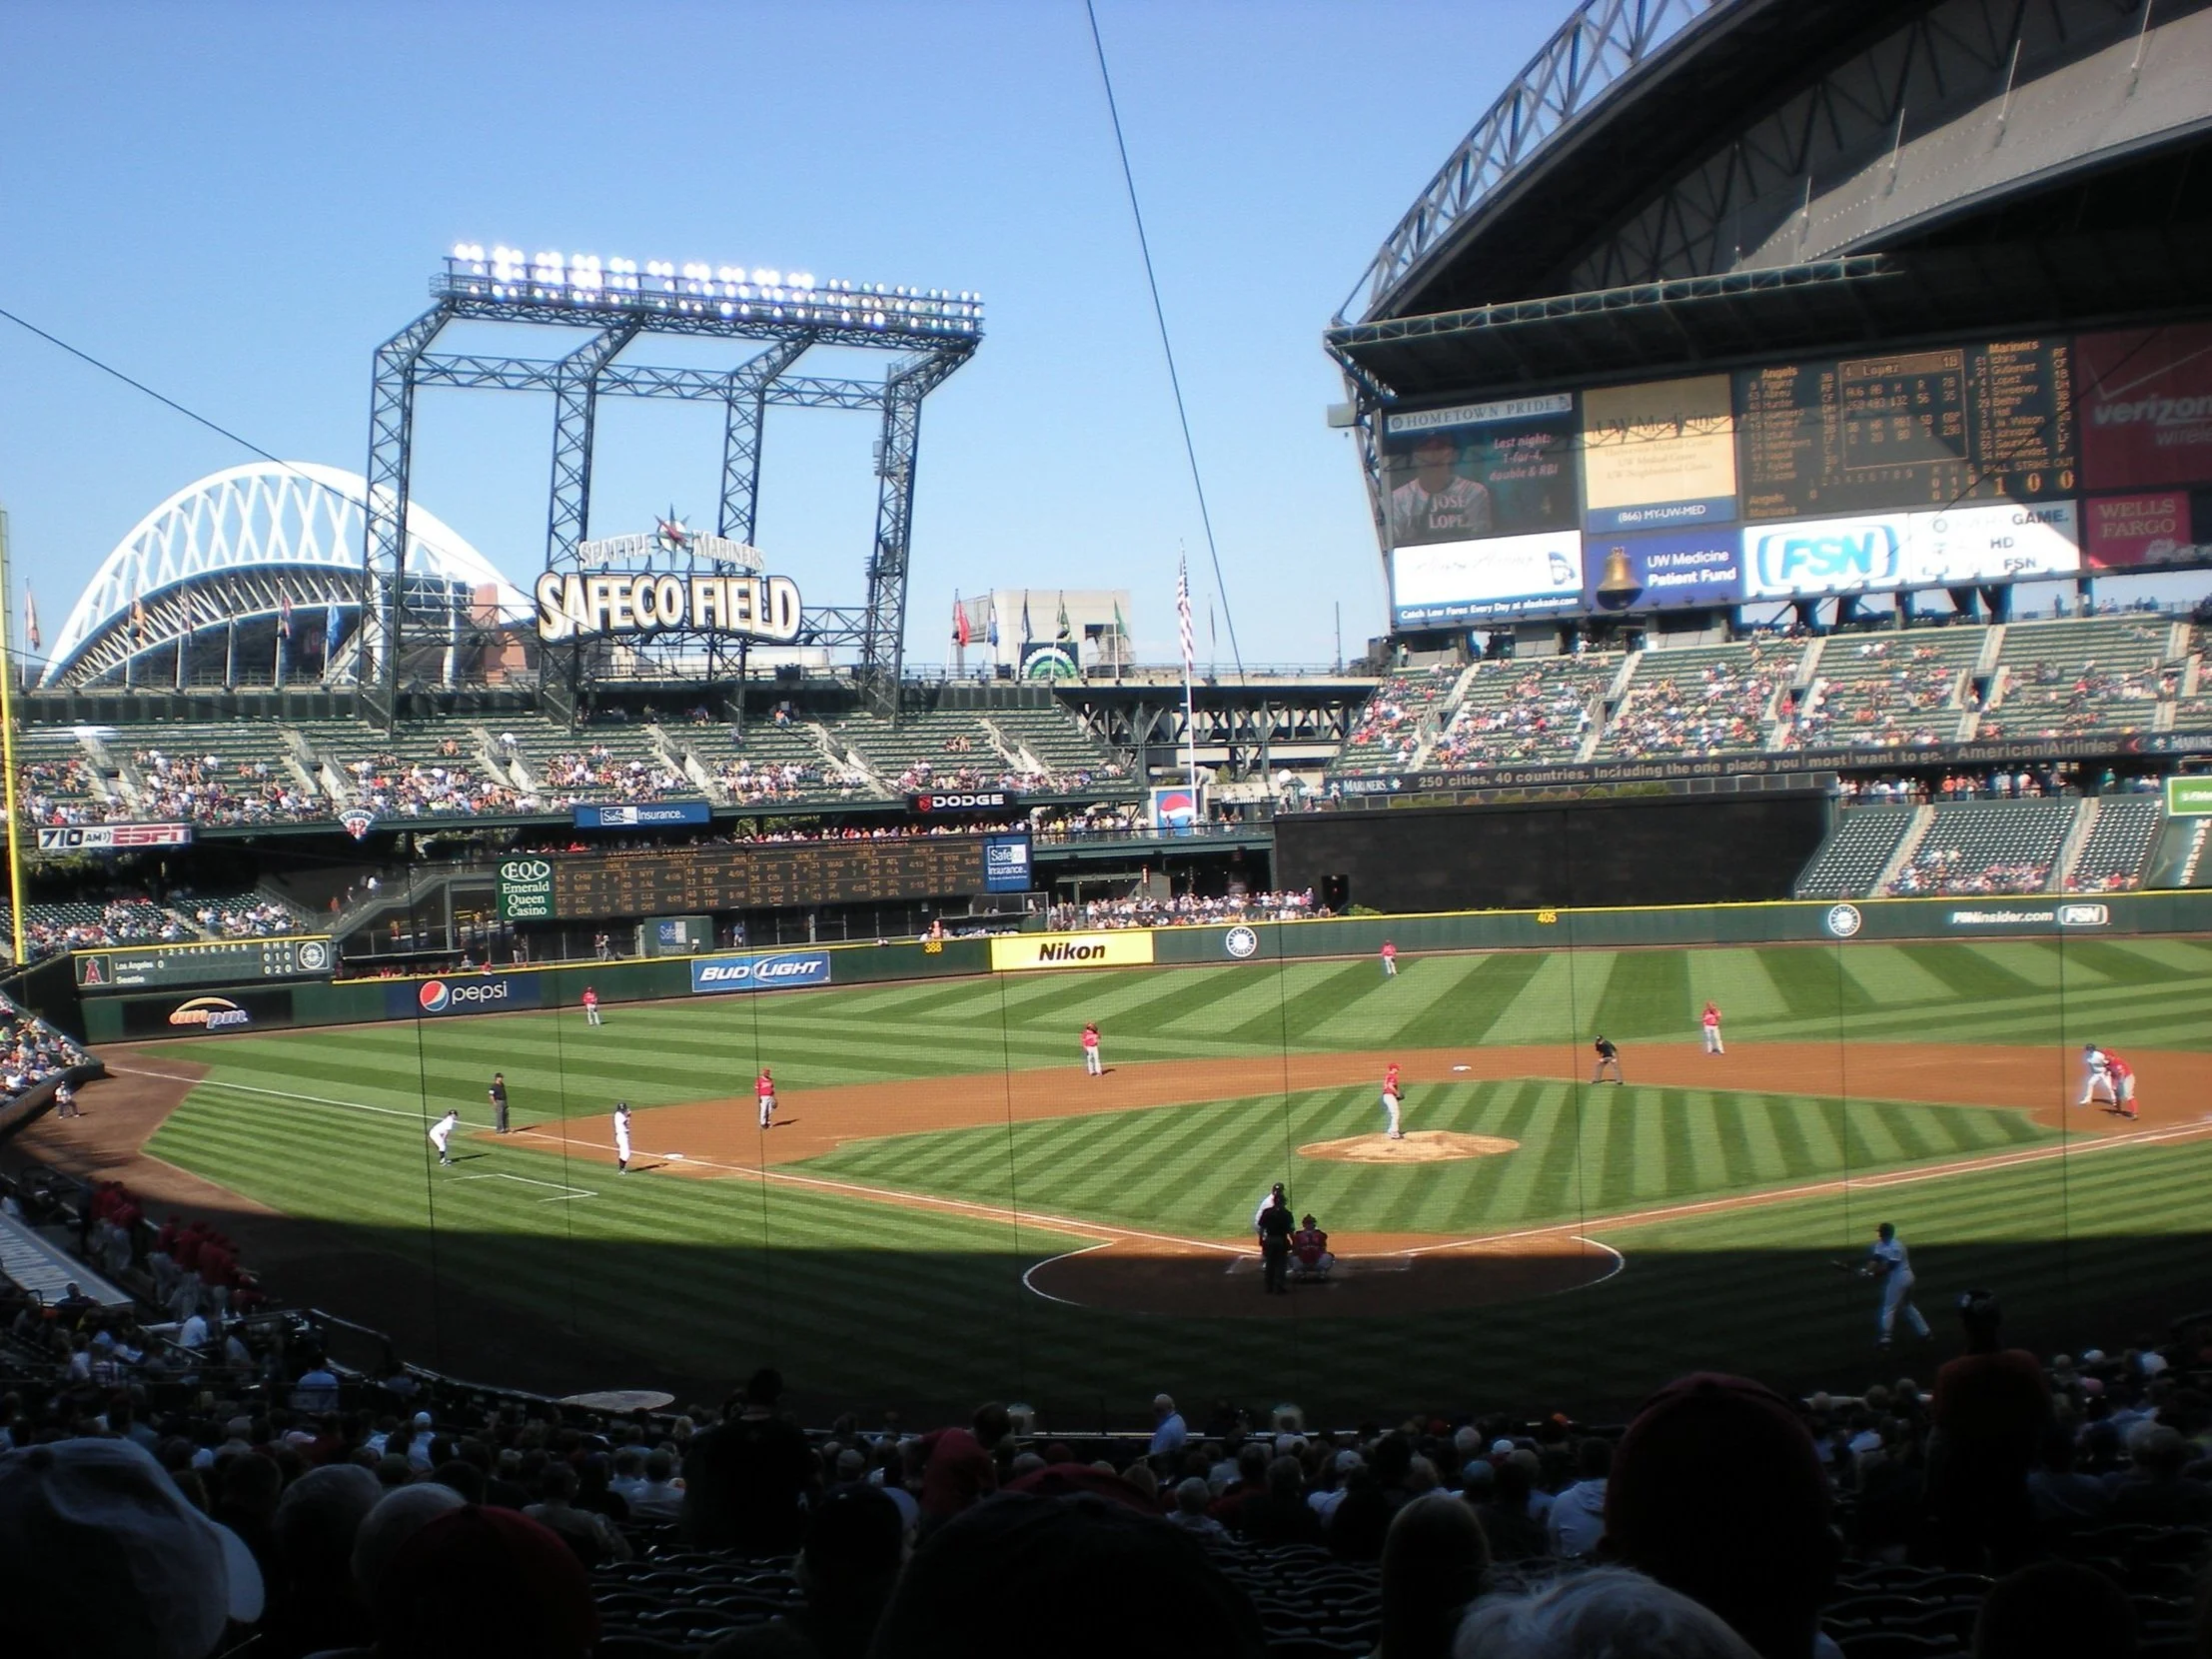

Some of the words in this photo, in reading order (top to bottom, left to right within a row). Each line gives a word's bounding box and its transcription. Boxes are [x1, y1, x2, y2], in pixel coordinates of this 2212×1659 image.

[1989, 341, 2038, 353] Mariners
[1762, 367, 1798, 379] Angels
[1863, 364, 1899, 377] Lopez
[1943, 356, 1958, 368] 1B
[1407, 406, 1498, 428] HOMETOWN
[1507, 399, 1555, 415] PRIDE
[1637, 409, 1720, 433] Medicine
[1494, 438, 1516, 450] Last
[2014, 459, 2050, 471] STRIKE
[2054, 457, 2074, 468] OUT
[2027, 473, 2042, 492] 0
[2059, 470, 2075, 489] 0
[1618, 512, 1643, 524] (866)
[1645, 504, 1706, 520] MY-UW-MED
[2011, 509, 2070, 527] GAME.
[2098, 499, 2175, 519] WELLS
[2102, 519, 2176, 538] FARGO
[578, 533, 653, 570] SEATTLE
[691, 530, 766, 573] MARINERS
[1989, 537, 2014, 550] HD
[1648, 556, 1670, 568] UW
[1672, 550, 1729, 566] Medicine
[1780, 532, 1875, 579] FSN
[2003, 557, 2037, 571] FSN
[1649, 571, 1698, 588] Patient
[1701, 567, 1737, 583] Fund
[536, 571, 686, 644] SAFECO
[689, 574, 801, 645] FIELD
[1401, 610, 1426, 620] Catch
[1428, 608, 1445, 618] Low
[1446, 606, 1469, 616] Fares
[1470, 604, 1494, 616] Every
[1495, 602, 1512, 614] Day
[1513, 602, 1522, 611] at
[1343, 779, 1387, 793] MARINERS
[1418, 777, 1444, 789] 250
[1449, 774, 1491, 787] cities.
[1495, 772, 1512, 784] 40
[1516, 769, 1591, 784] countries.
[1595, 765, 1663, 781] Including
[1666, 763, 1689, 775] the
[1693, 760, 1720, 774] one
[1773, 758, 1798, 772] you
[1809, 754, 1847, 768] most
[1856, 751, 1894, 765] want
[1901, 751, 1915, 763] to
[932, 794, 1004, 808] DODGE
[602, 809, 636, 826] Safe
[638, 810, 681, 822] Insurance
[42, 830, 83, 847] 710
[85, 833, 101, 842] AM
[112, 824, 192, 844] ESPN
[509, 861, 549, 879] EQC
[502, 881, 551, 893] Emerald
[508, 893, 546, 906] Queen
[507, 905, 548, 917] Casino
[1538, 911, 1558, 923] 405
[1952, 910, 2054, 925] FSNinsider.com
[2065, 905, 2100, 923] FSN
[115, 961, 128, 970] Los
[157, 959, 164, 969] 0
[263, 952, 270, 961] 0
[284, 951, 291, 961] 0
[1039, 941, 1106, 961] Nikon
[116, 974, 145, 984] Seattle
[264, 964, 271, 974] 0
[275, 964, 281, 974] 2
[285, 964, 292, 973] 0
[699, 962, 751, 982] BUD
[759, 958, 824, 978] LIGHT
[452, 980, 510, 1003] pepsi
